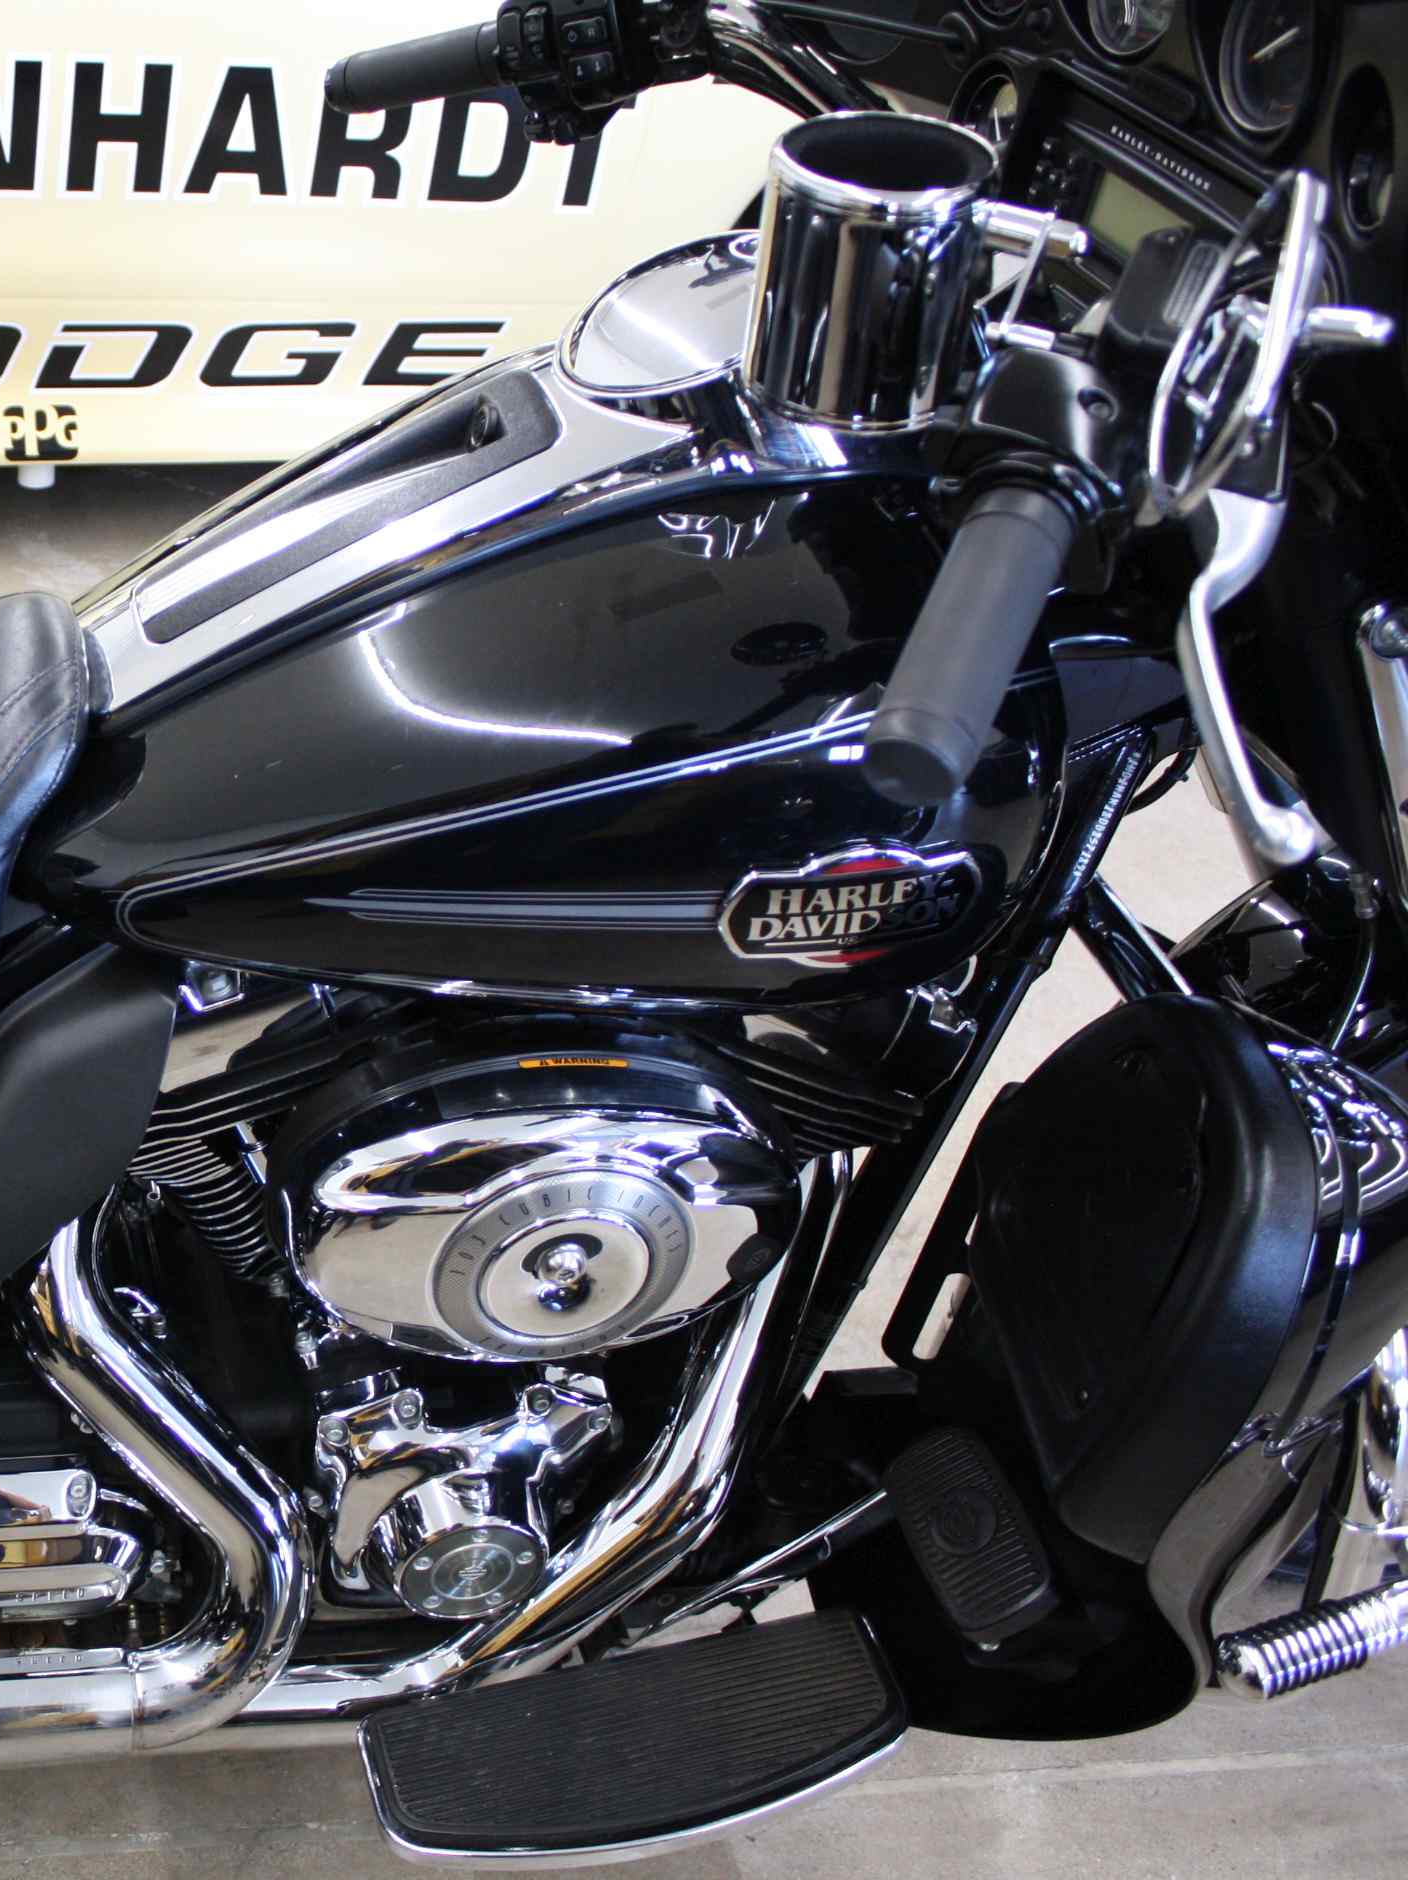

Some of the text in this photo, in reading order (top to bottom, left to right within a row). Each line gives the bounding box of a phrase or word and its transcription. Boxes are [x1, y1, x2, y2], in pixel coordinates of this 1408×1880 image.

[1, 402, 79, 460] PPG
[747, 892, 960, 941] DAVIDSON
[552, 1057, 610, 1066] WARNING
[498, 1186, 592, 1227] CUBIC
[616, 1188, 683, 1252] INCHES
[15, 1587, 86, 1603] SPEED
